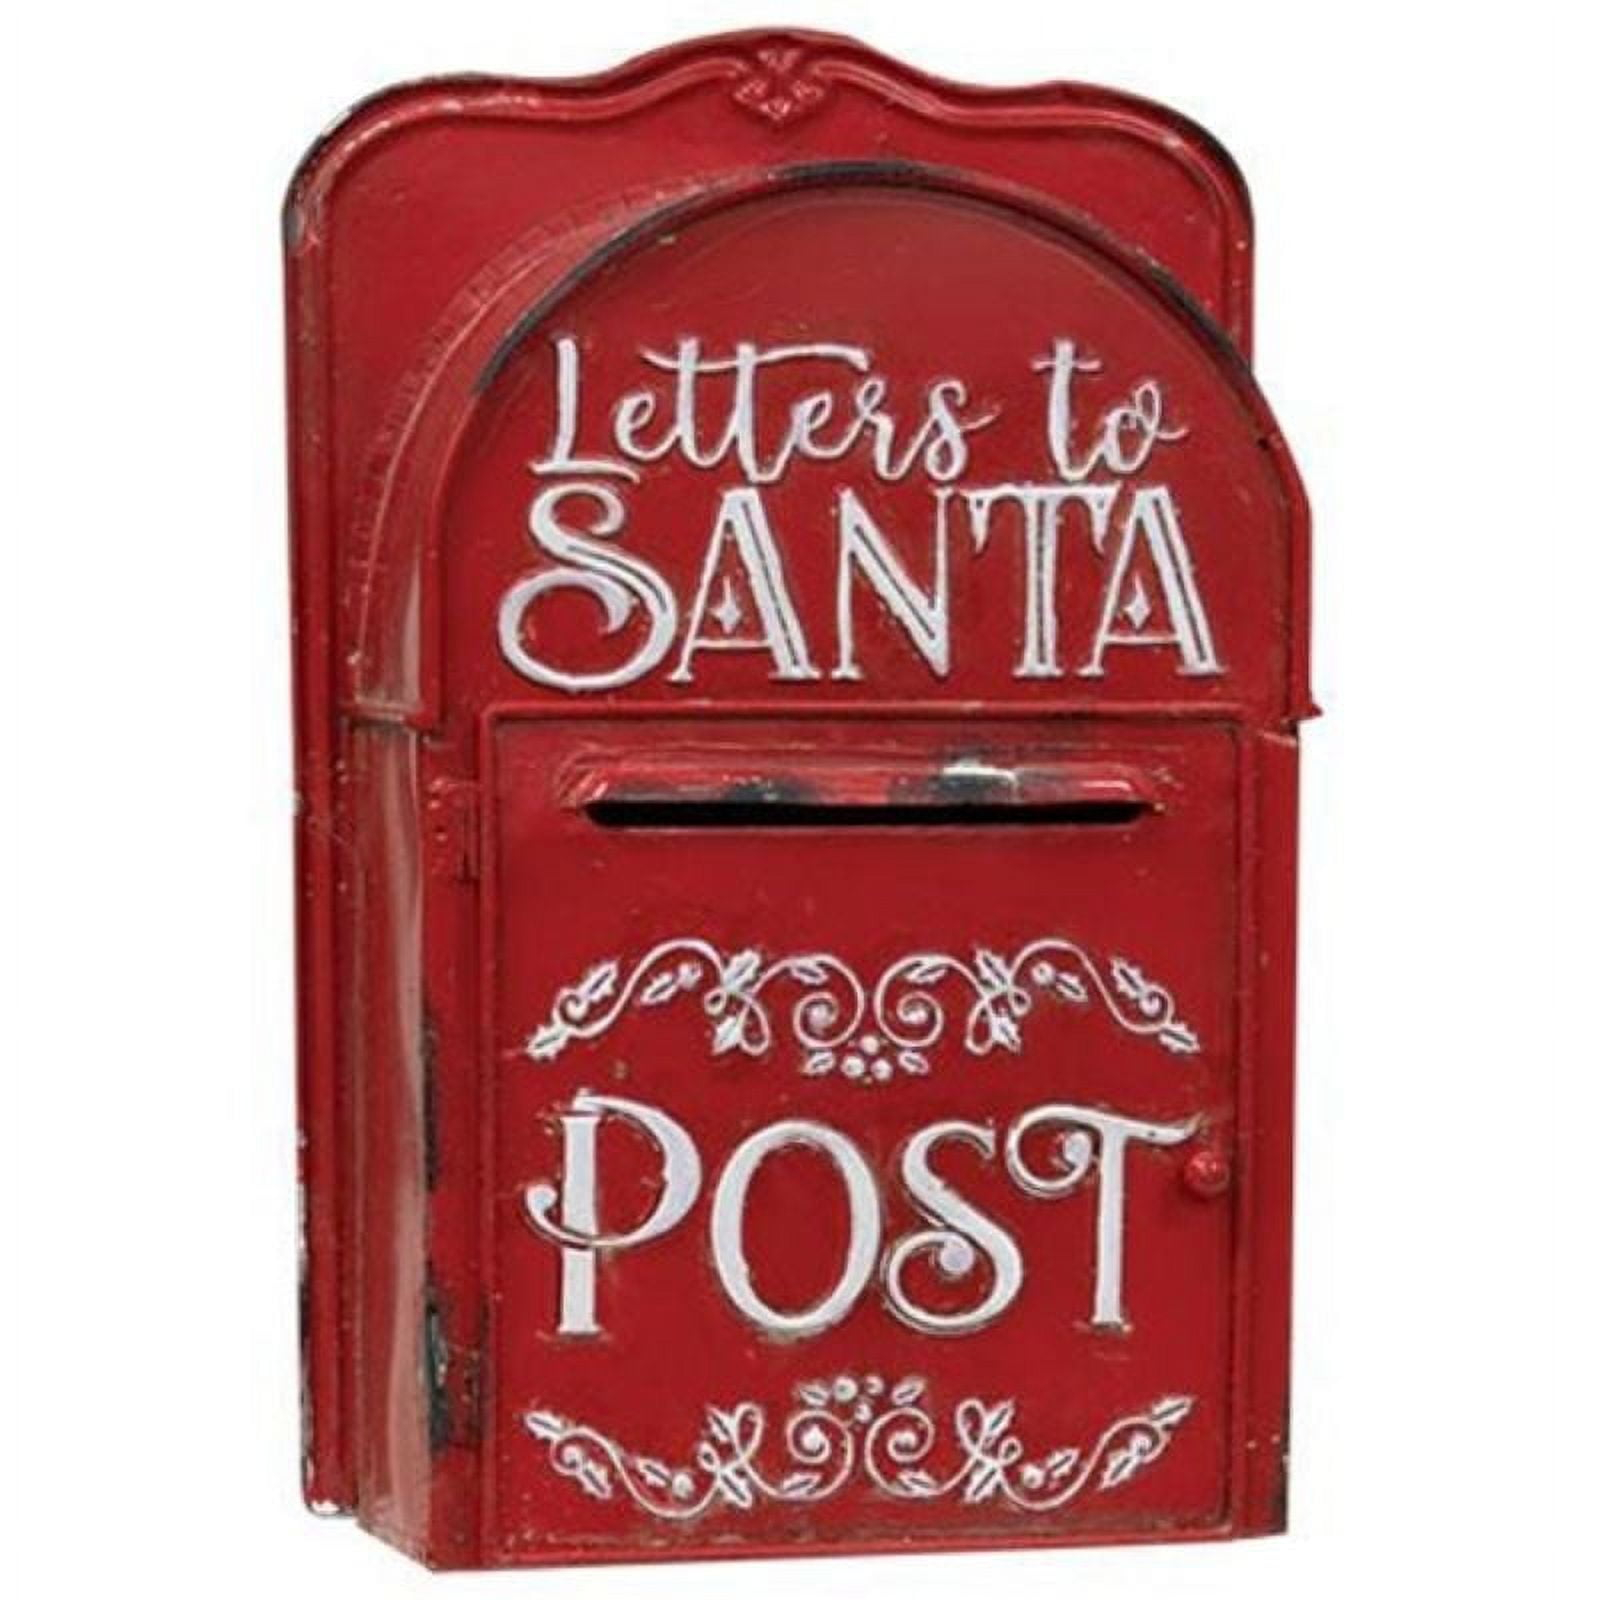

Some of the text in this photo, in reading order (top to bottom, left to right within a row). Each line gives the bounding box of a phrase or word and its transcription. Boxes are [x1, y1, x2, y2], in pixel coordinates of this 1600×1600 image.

[530, 338, 1188, 482] Letters to
[497, 482, 1223, 691] SANTA
[526, 1091, 1202, 1338] POST
